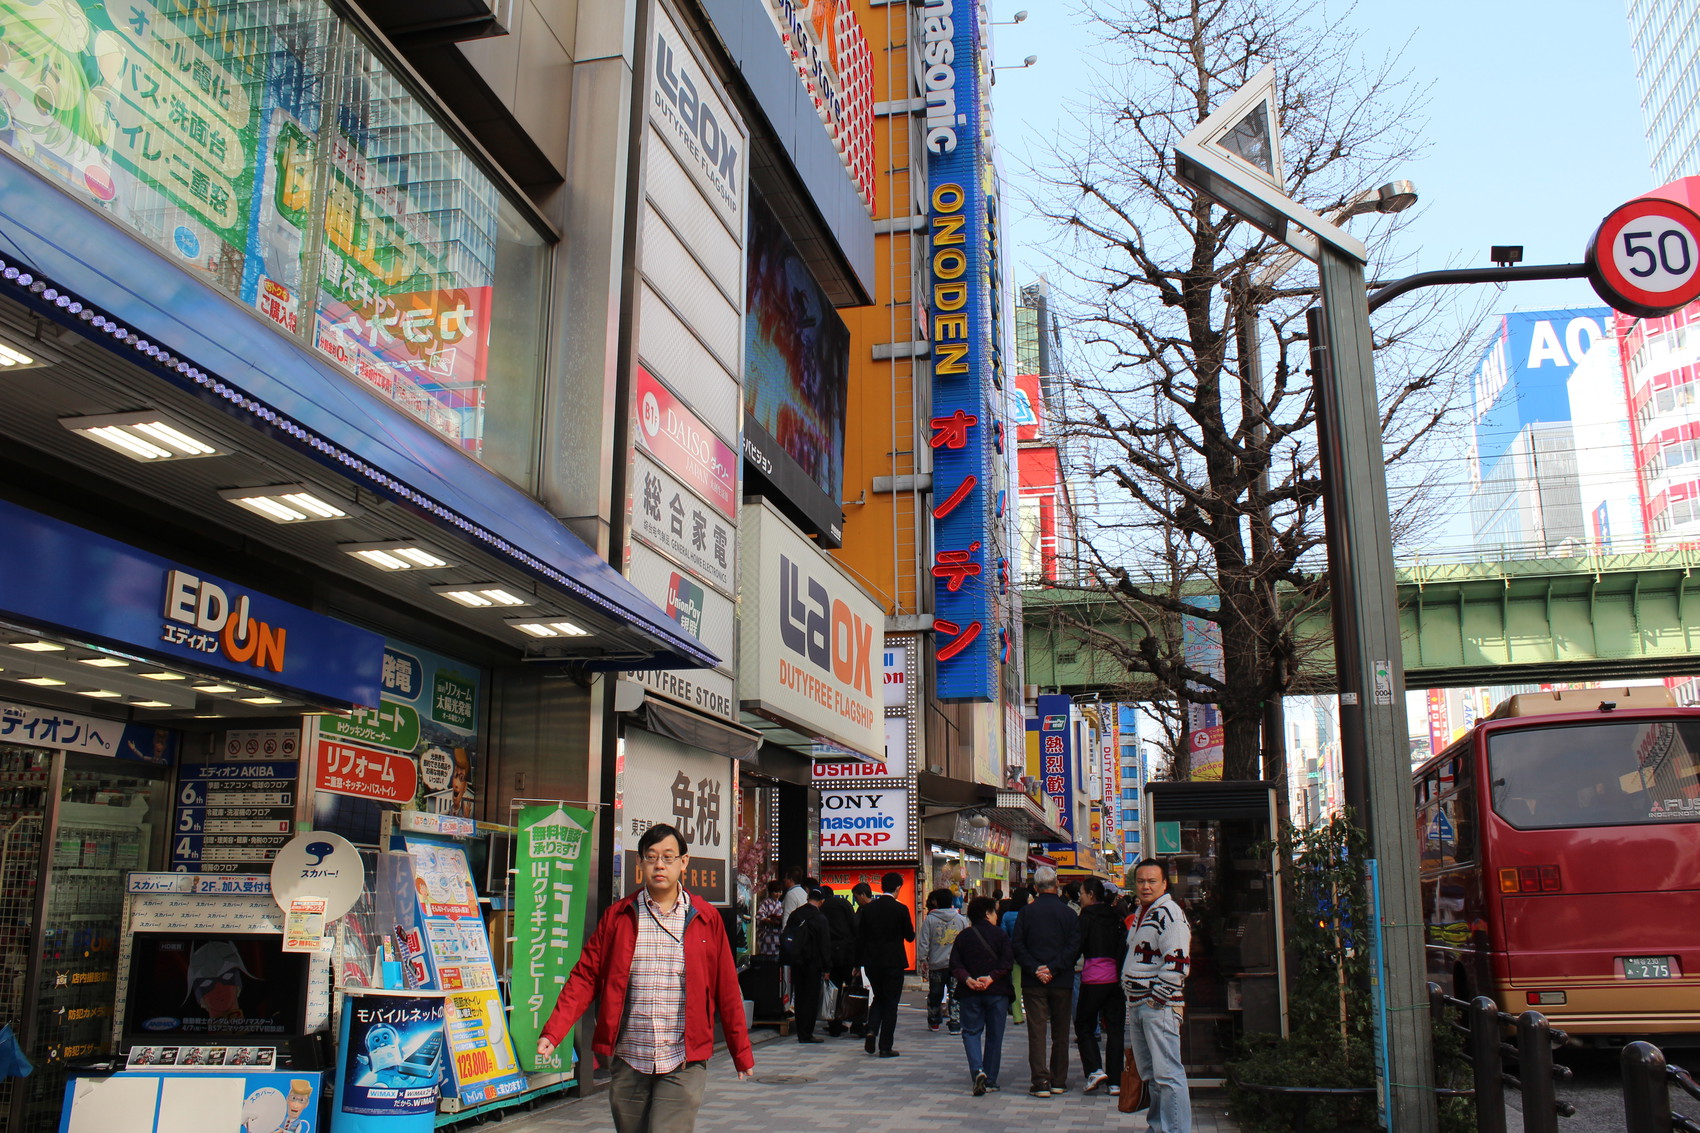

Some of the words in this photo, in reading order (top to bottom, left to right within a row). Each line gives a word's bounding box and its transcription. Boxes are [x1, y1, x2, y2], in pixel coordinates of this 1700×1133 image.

[779, 0, 808, 57] nics
[812, 46, 841, 121] Store
[655, 90, 700, 164] DUTYFREE
[701, 157, 738, 214] FLAGSHIP
[1623, 230, 1690, 277] 50
[931, 183, 969, 376] ONODEN
[667, 408, 710, 464] DAISO
[686, 457, 709, 485] JAPAN
[711, 456, 729, 478] ダイソー
[643, 471, 728, 570] 総合家電
[930, 409, 982, 662] オノデン
[671, 538, 690, 560] GENERAL
[690, 552, 702, 568] HOME
[702, 557, 727, 584] ELECTRONICS
[164, 569, 287, 673] EDION
[668, 587, 701, 625] UnionPay
[163, 624, 219, 653] エディオン
[696, 686, 730, 716] STORE
[779, 658, 833, 710] DUTYFREE
[835, 692, 874, 731] FLAGSHIP
[337, 721, 391, 742] IHクッキングヒーター
[199, 767, 239, 777] エディオン
[240, 766, 274, 777] AKIBA
[327, 746, 395, 783] リフォーム
[1103, 746, 1112, 773] DUTY
[1104, 776, 1113, 802] FREE
[670, 770, 721, 847] 免税
[1105, 805, 1114, 833] SHOP
[532, 825, 581, 843] 無料相談
[533, 840, 577, 857] 承ります!
[681, 869, 717, 888] FREE
[528, 861, 550, 1030] IHクッキングヒーター
